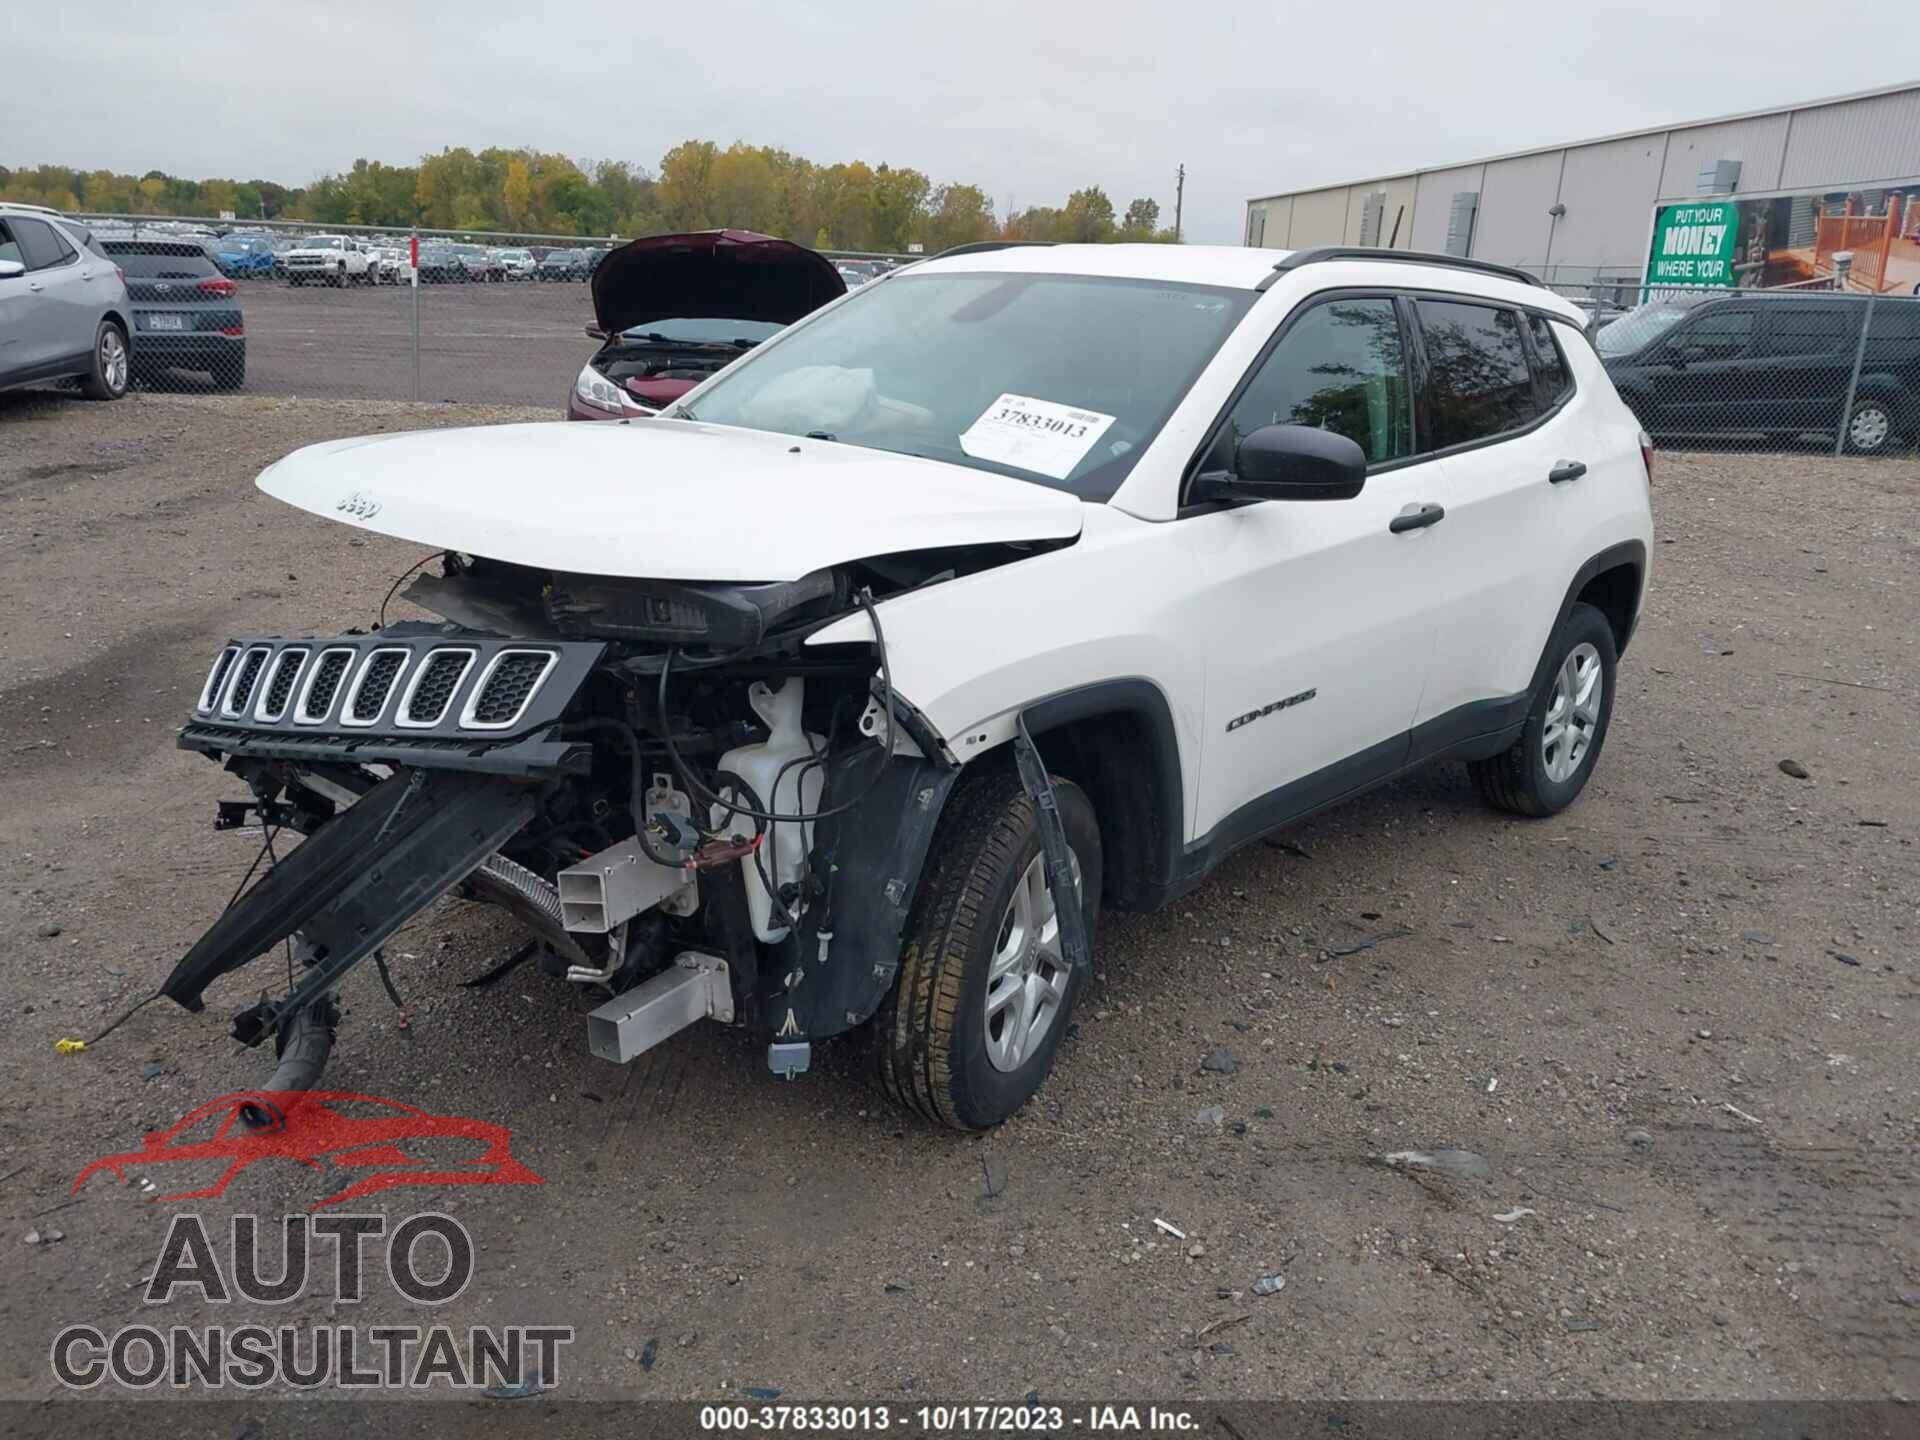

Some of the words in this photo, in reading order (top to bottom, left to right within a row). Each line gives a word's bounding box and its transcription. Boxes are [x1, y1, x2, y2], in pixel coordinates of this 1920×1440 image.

[1675, 210, 1694, 223] PUT
[1694, 208, 1723, 223] YOUR
[1662, 225, 1727, 255] MONEY
[1657, 261, 1695, 277] WHERE
[1697, 260, 1724, 277] YOUR
[993, 408, 1087, 437] 37833013
